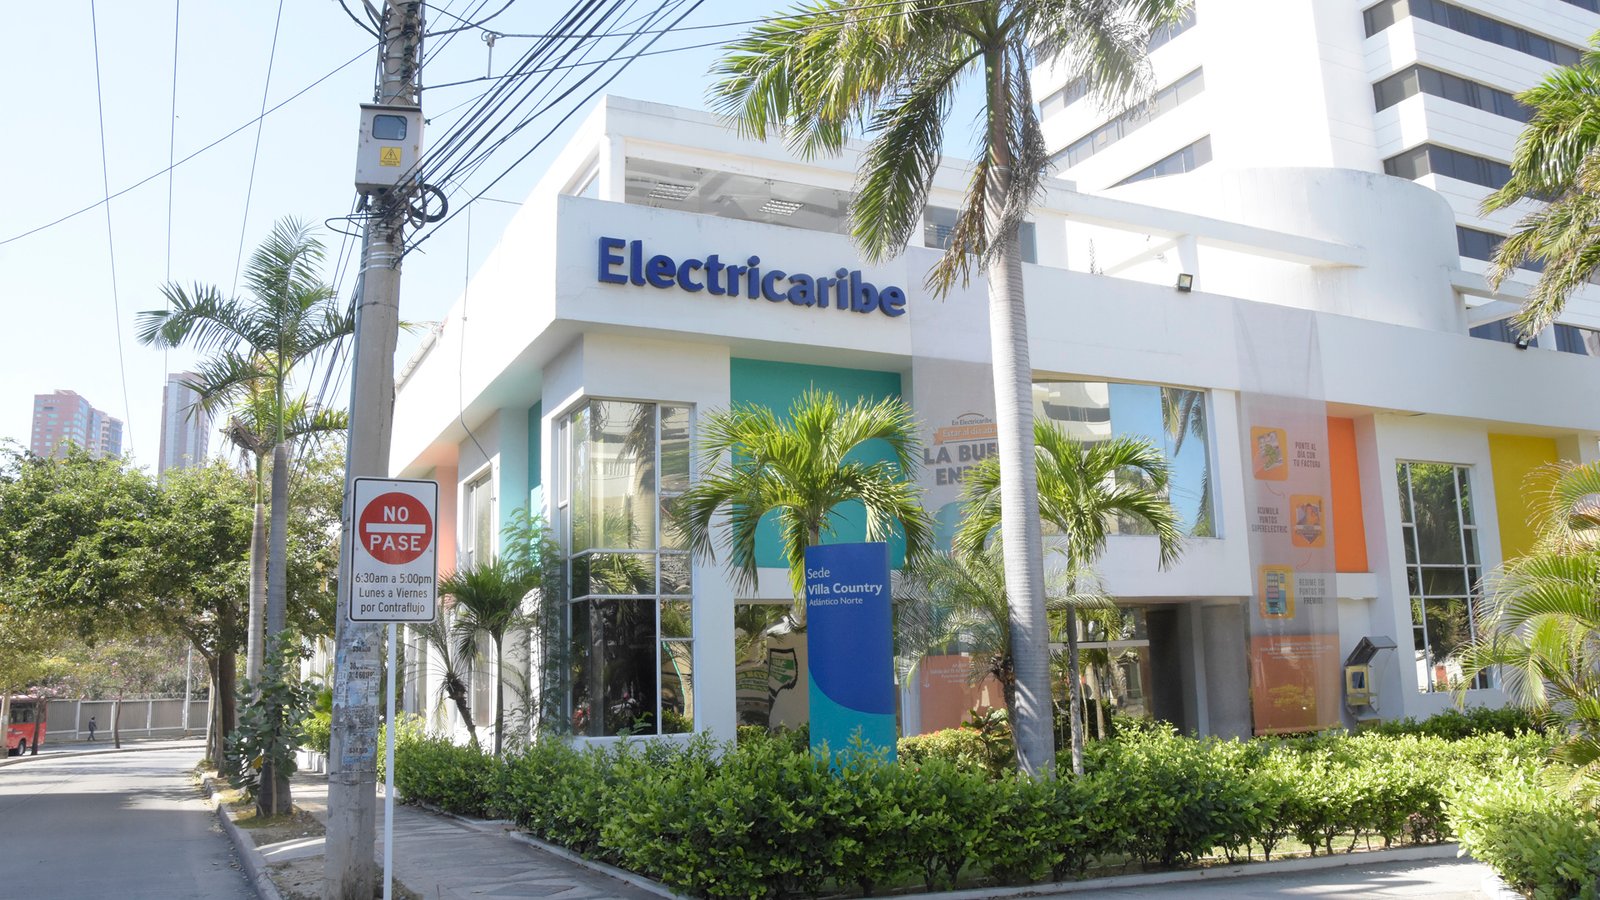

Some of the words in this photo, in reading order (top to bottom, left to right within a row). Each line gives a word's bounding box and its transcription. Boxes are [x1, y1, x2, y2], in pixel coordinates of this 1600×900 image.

[598, 236, 906, 318] Electricaribe
[923, 446, 952, 465] LA
[958, 442, 999, 462] BUE
[383, 506, 409, 522] NO
[370, 534, 422, 551] PASE
[355, 572, 389, 584] 6:30am
[399, 573, 432, 588] 5:00pm
[807, 567, 831, 579] Sede
[359, 587, 385, 598] Lunes
[388, 590, 393, 598] a
[396, 587, 428, 598] Viernes
[807, 583, 830, 595] Villa
[832, 582, 883, 596] Country
[360, 603, 375, 615] por
[378, 602, 425, 615] Contraflujo
[808, 597, 839, 607] Atlántico
[840, 597, 864, 605] Norte
